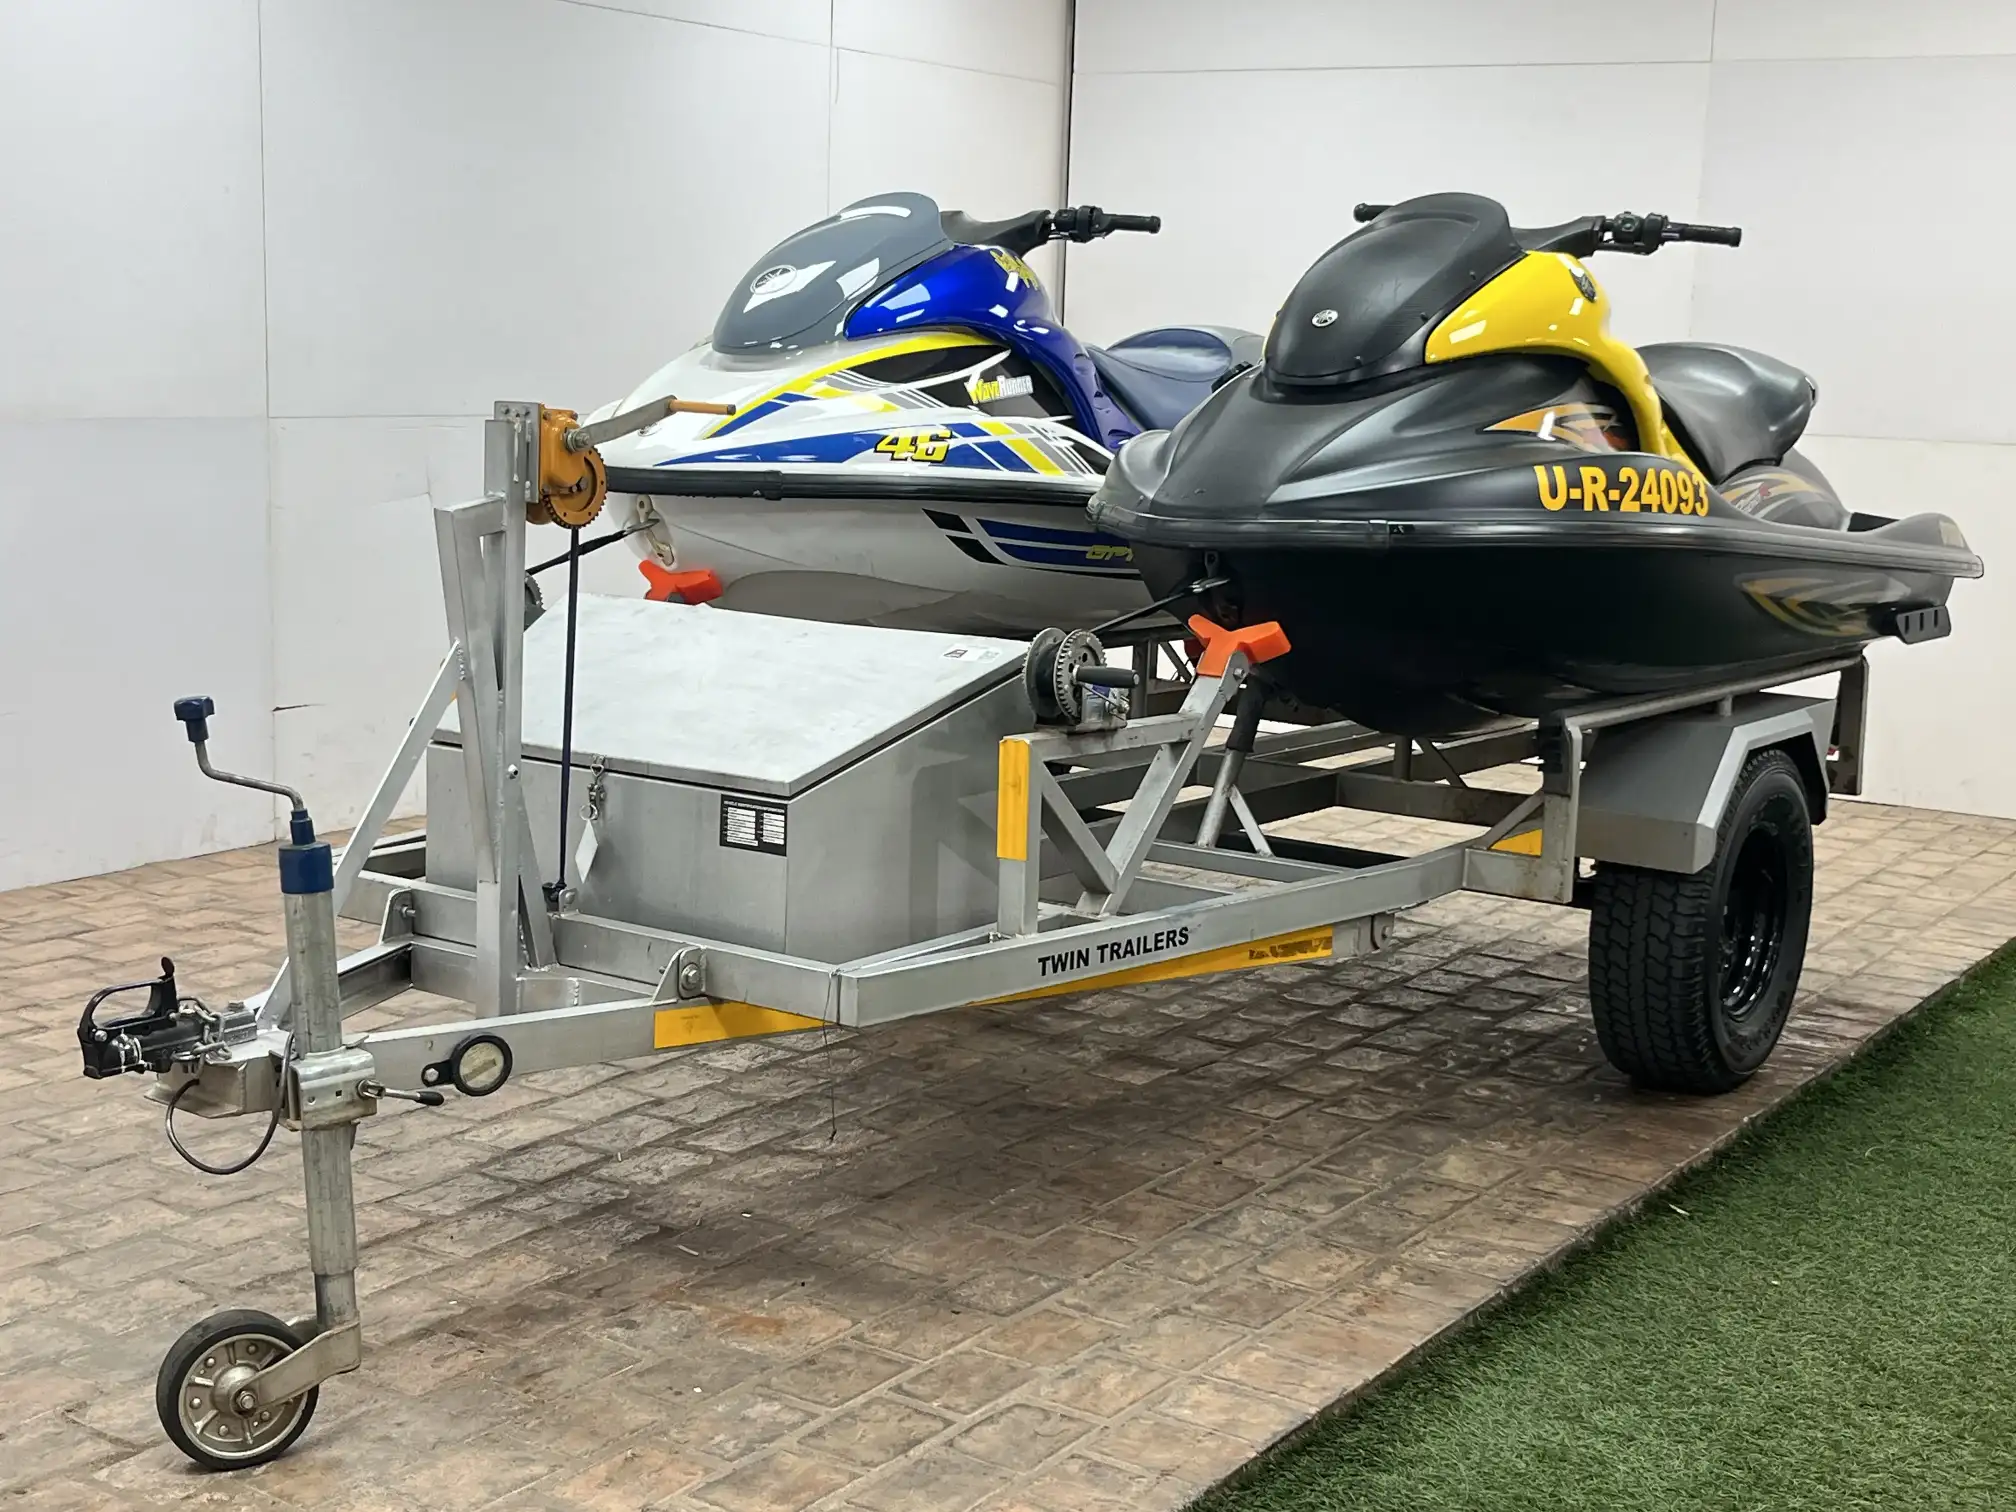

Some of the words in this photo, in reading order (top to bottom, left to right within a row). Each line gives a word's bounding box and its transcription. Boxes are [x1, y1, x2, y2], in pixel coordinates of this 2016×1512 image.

[874, 428, 953, 463] 46
[1533, 465, 1709, 517] U-R-24093
[1038, 947, 1090, 977] TWIN
[1096, 926, 1189, 964] TRAILERS
